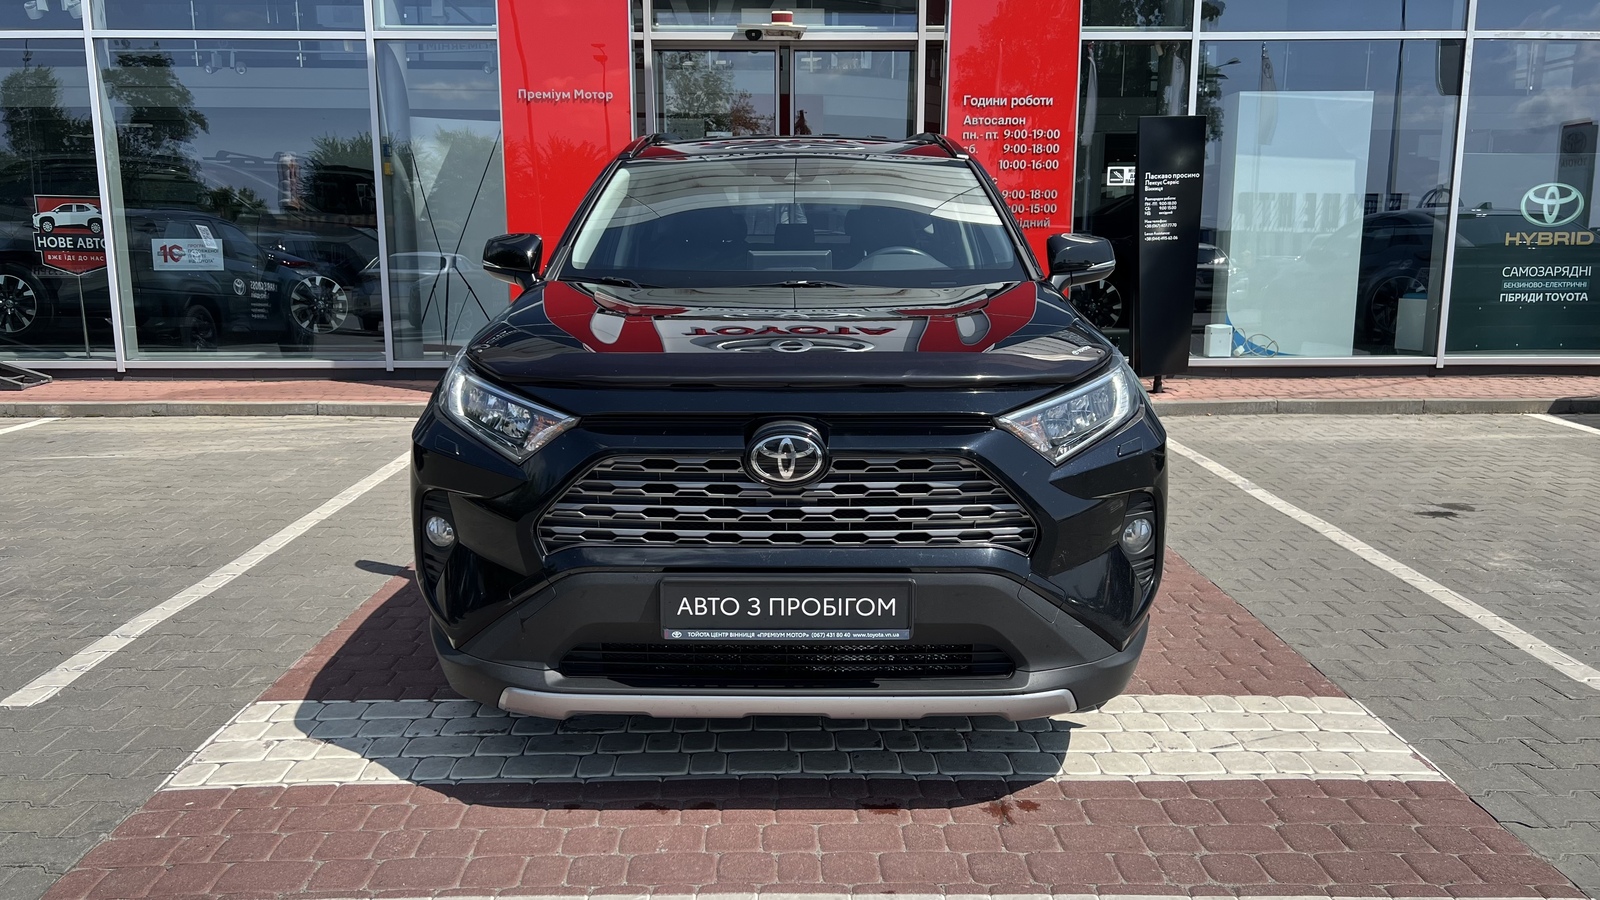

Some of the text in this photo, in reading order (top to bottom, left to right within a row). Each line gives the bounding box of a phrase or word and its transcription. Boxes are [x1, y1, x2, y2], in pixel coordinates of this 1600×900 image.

[518, 88, 614, 102] Преміум Мотор
[963, 95, 1053, 108] Години роботи
[963, 115, 1026, 125] Автосалон
[998, 160, 1059, 170] 10:00-16:00
[1009, 203, 1057, 214] :00-15:00
[37, 236, 74, 248] НОВЕ
[1505, 231, 1595, 246] HYBRID
[1502, 266, 1591, 278] САМОЗАРЯДНІ
[1499, 292, 1589, 304] ГІБРИДИ TOYOTA
[677, 597, 896, 616] АВТО З ПРОБІГОМ
